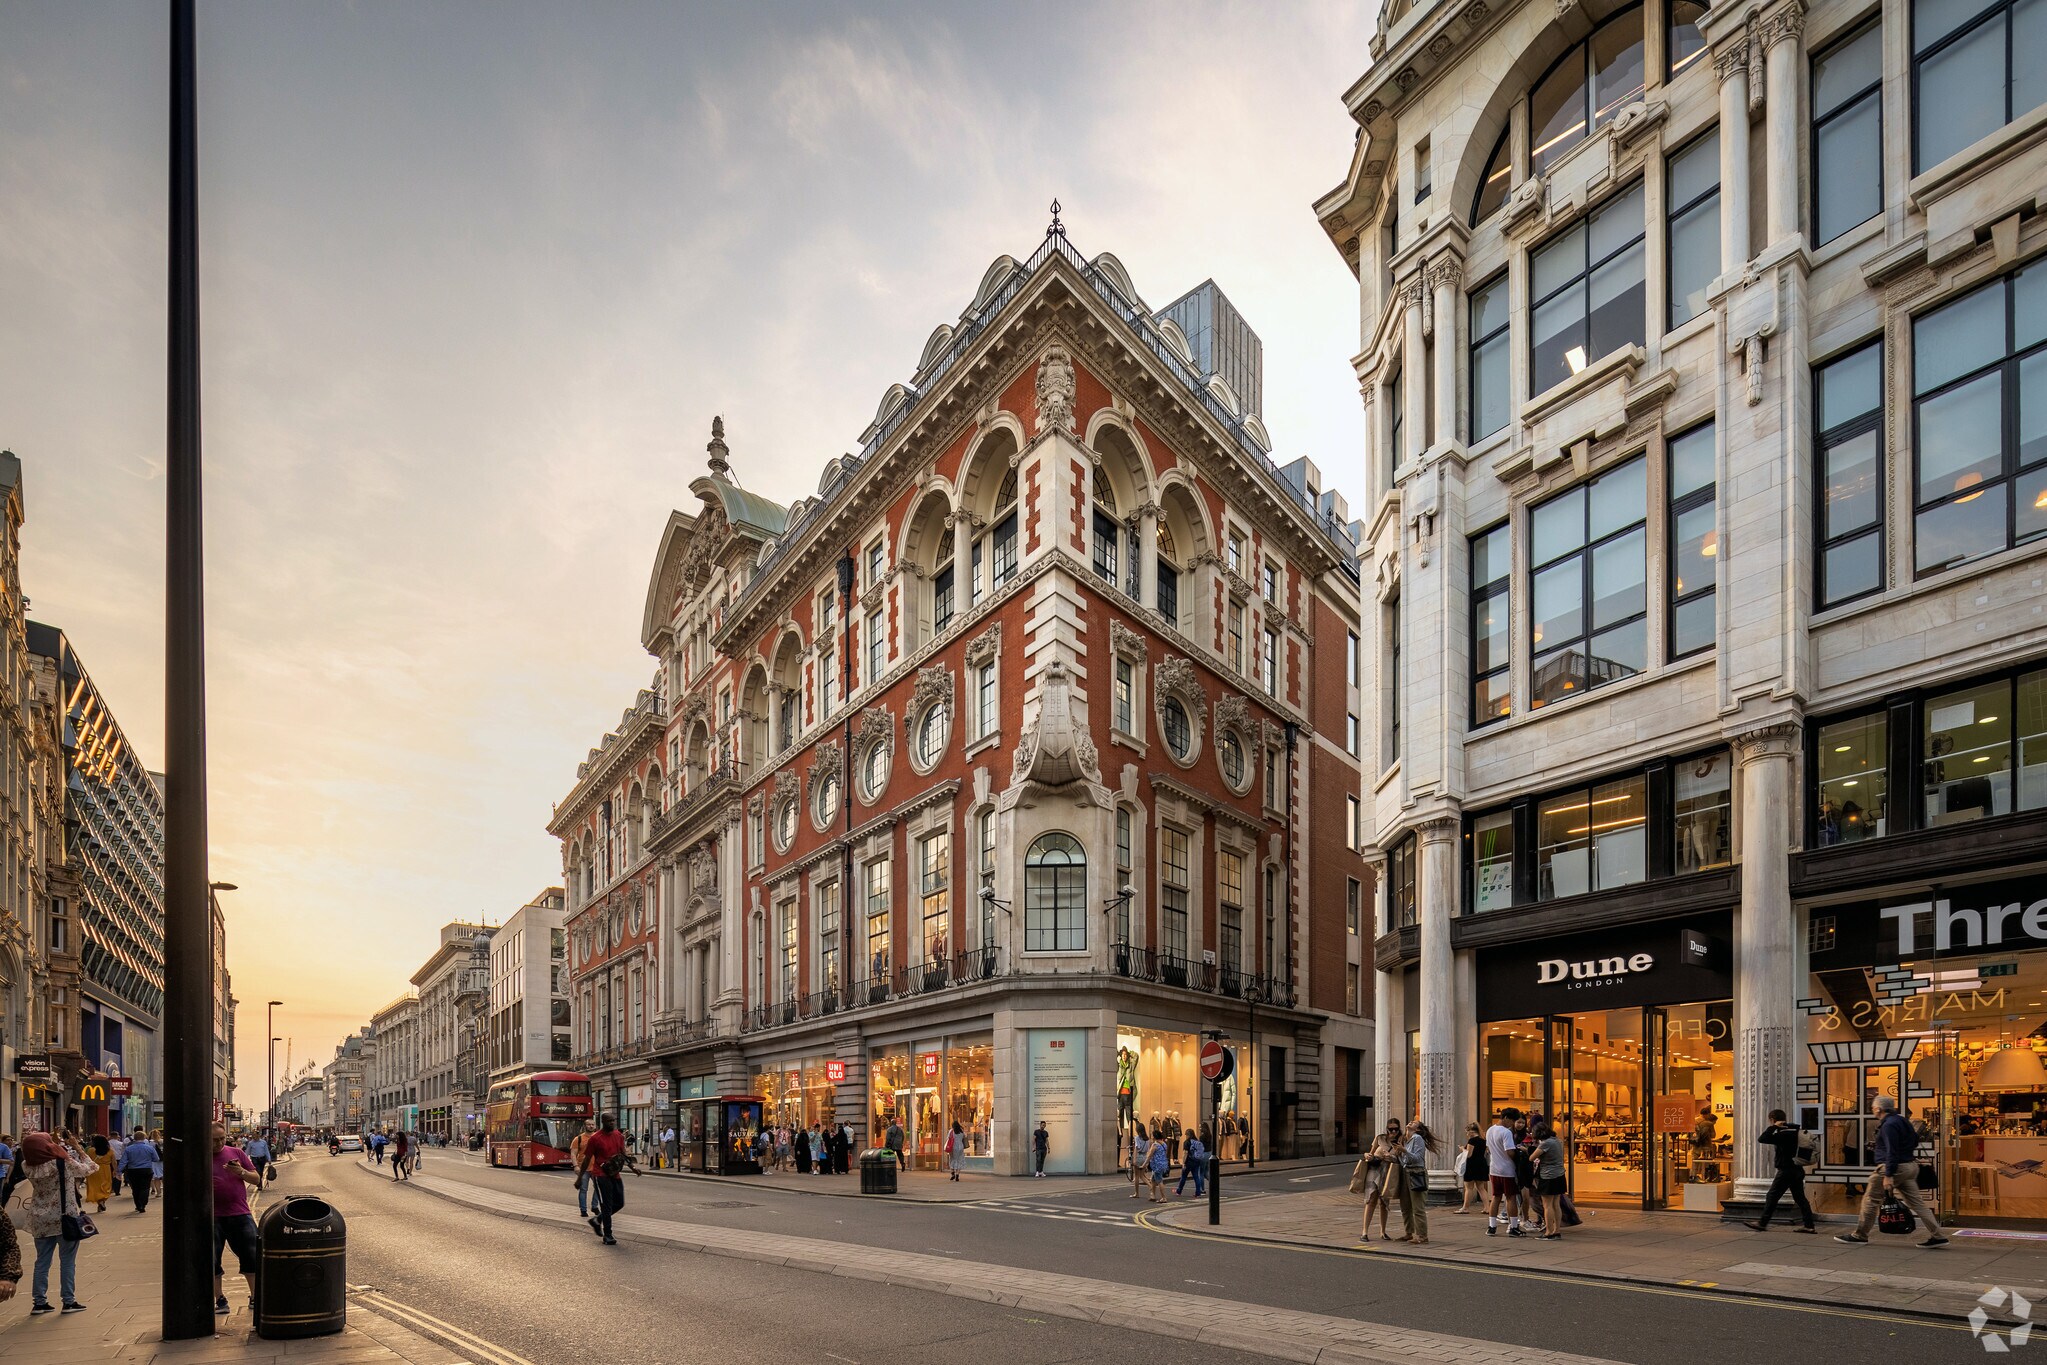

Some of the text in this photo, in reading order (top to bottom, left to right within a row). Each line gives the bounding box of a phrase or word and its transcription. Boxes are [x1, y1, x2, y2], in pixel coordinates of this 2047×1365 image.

[1690, 940, 1707, 954] Dune
[1537, 953, 1654, 984] Dune
[1567, 977, 1624, 990] LONDON
[927, 1055, 935, 1065] UNI
[828, 1063, 842, 1071] UNI
[926, 1065, 936, 1075] QLO
[828, 1071, 843, 1080] QLO
[575, 1104, 585, 1112] 390
[1663, 1107, 1684, 1117] £25
[1663, 1117, 1684, 1126] OFF
[1880, 1213, 1905, 1224] SALE
